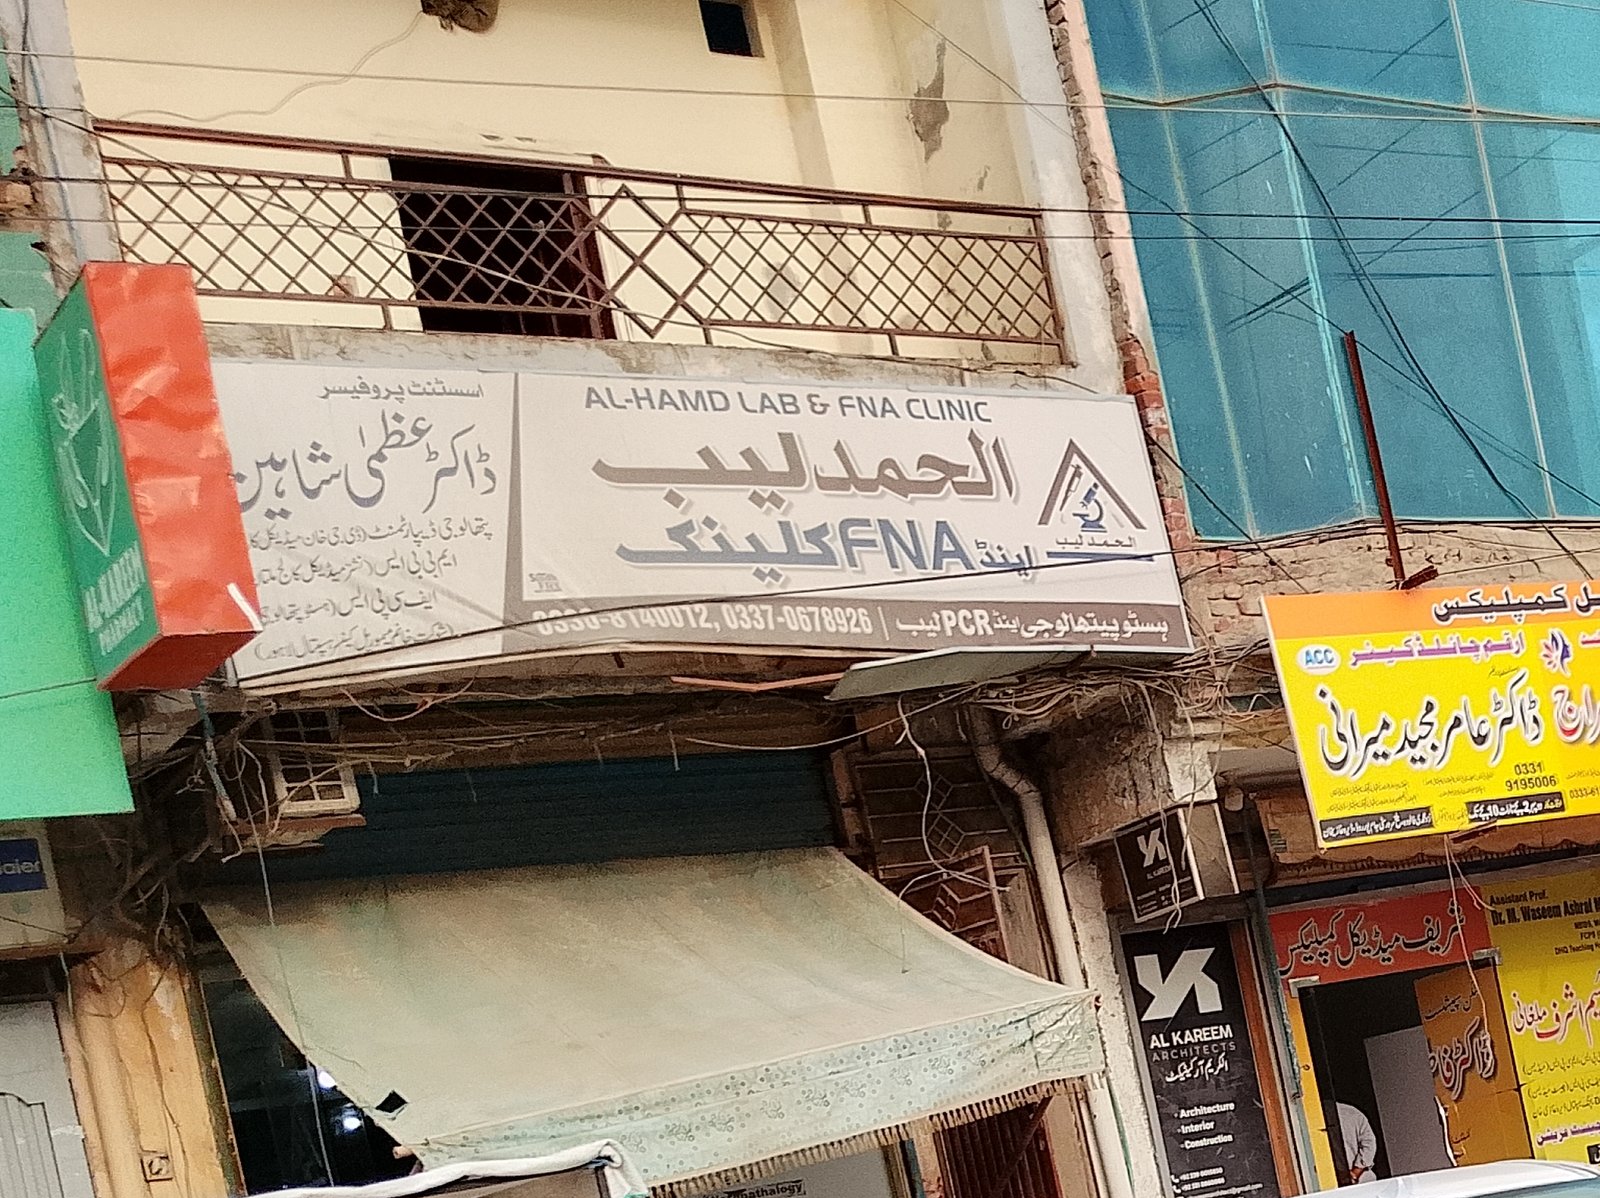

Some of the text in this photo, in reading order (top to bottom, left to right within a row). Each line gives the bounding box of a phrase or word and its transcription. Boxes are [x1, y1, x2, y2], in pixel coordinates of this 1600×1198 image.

[318, 375, 485, 403] اسسٹنٹ پروفیسر
[585, 386, 992, 423] AL-HAMD LAB & FNA CLINIC
[234, 441, 342, 520] شاہین
[422, 424, 497, 514] ڈاکٹر
[591, 427, 1014, 510] الحمد لیب
[615, 515, 1034, 583] اینڈ FNA کلینک
[1434, 587, 1567, 622] کمپلیکس
[721, 604, 873, 634] 0337-0678926
[896, 612, 941, 637] لیب
[940, 610, 994, 636] PCR
[1122, 610, 1169, 642] ہسٹو
[1305, 649, 1335, 667] ACC
[1318, 671, 1541, 776] ڈاکٹر عامر مجید میرانی
[1514, 762, 1543, 776] 0331
[1505, 775, 1557, 792] 9195006
[1569, 785, 1600, 799] 0333-61
[0, 860, 42, 876] aier
[1489, 891, 1528, 906] Assistant
[1490, 909, 1506, 926] Dr.
[1506, 907, 1521, 924] M.
[1520, 904, 1563, 922] Waseem
[1278, 898, 1466, 976] شریف میڈیکل کمپلیکس
[1534, 983, 1584, 1043] اشرف
[1149, 1024, 1234, 1049] AL KAREEM
[1152, 1041, 1237, 1062] ARCHITECTS
[1450, 1016, 1495, 1100] ڈاکٹر
[1180, 1102, 1235, 1119] Architecture
[1181, 1120, 1215, 1134] Interior
[1184, 1135, 1234, 1150] Construction
